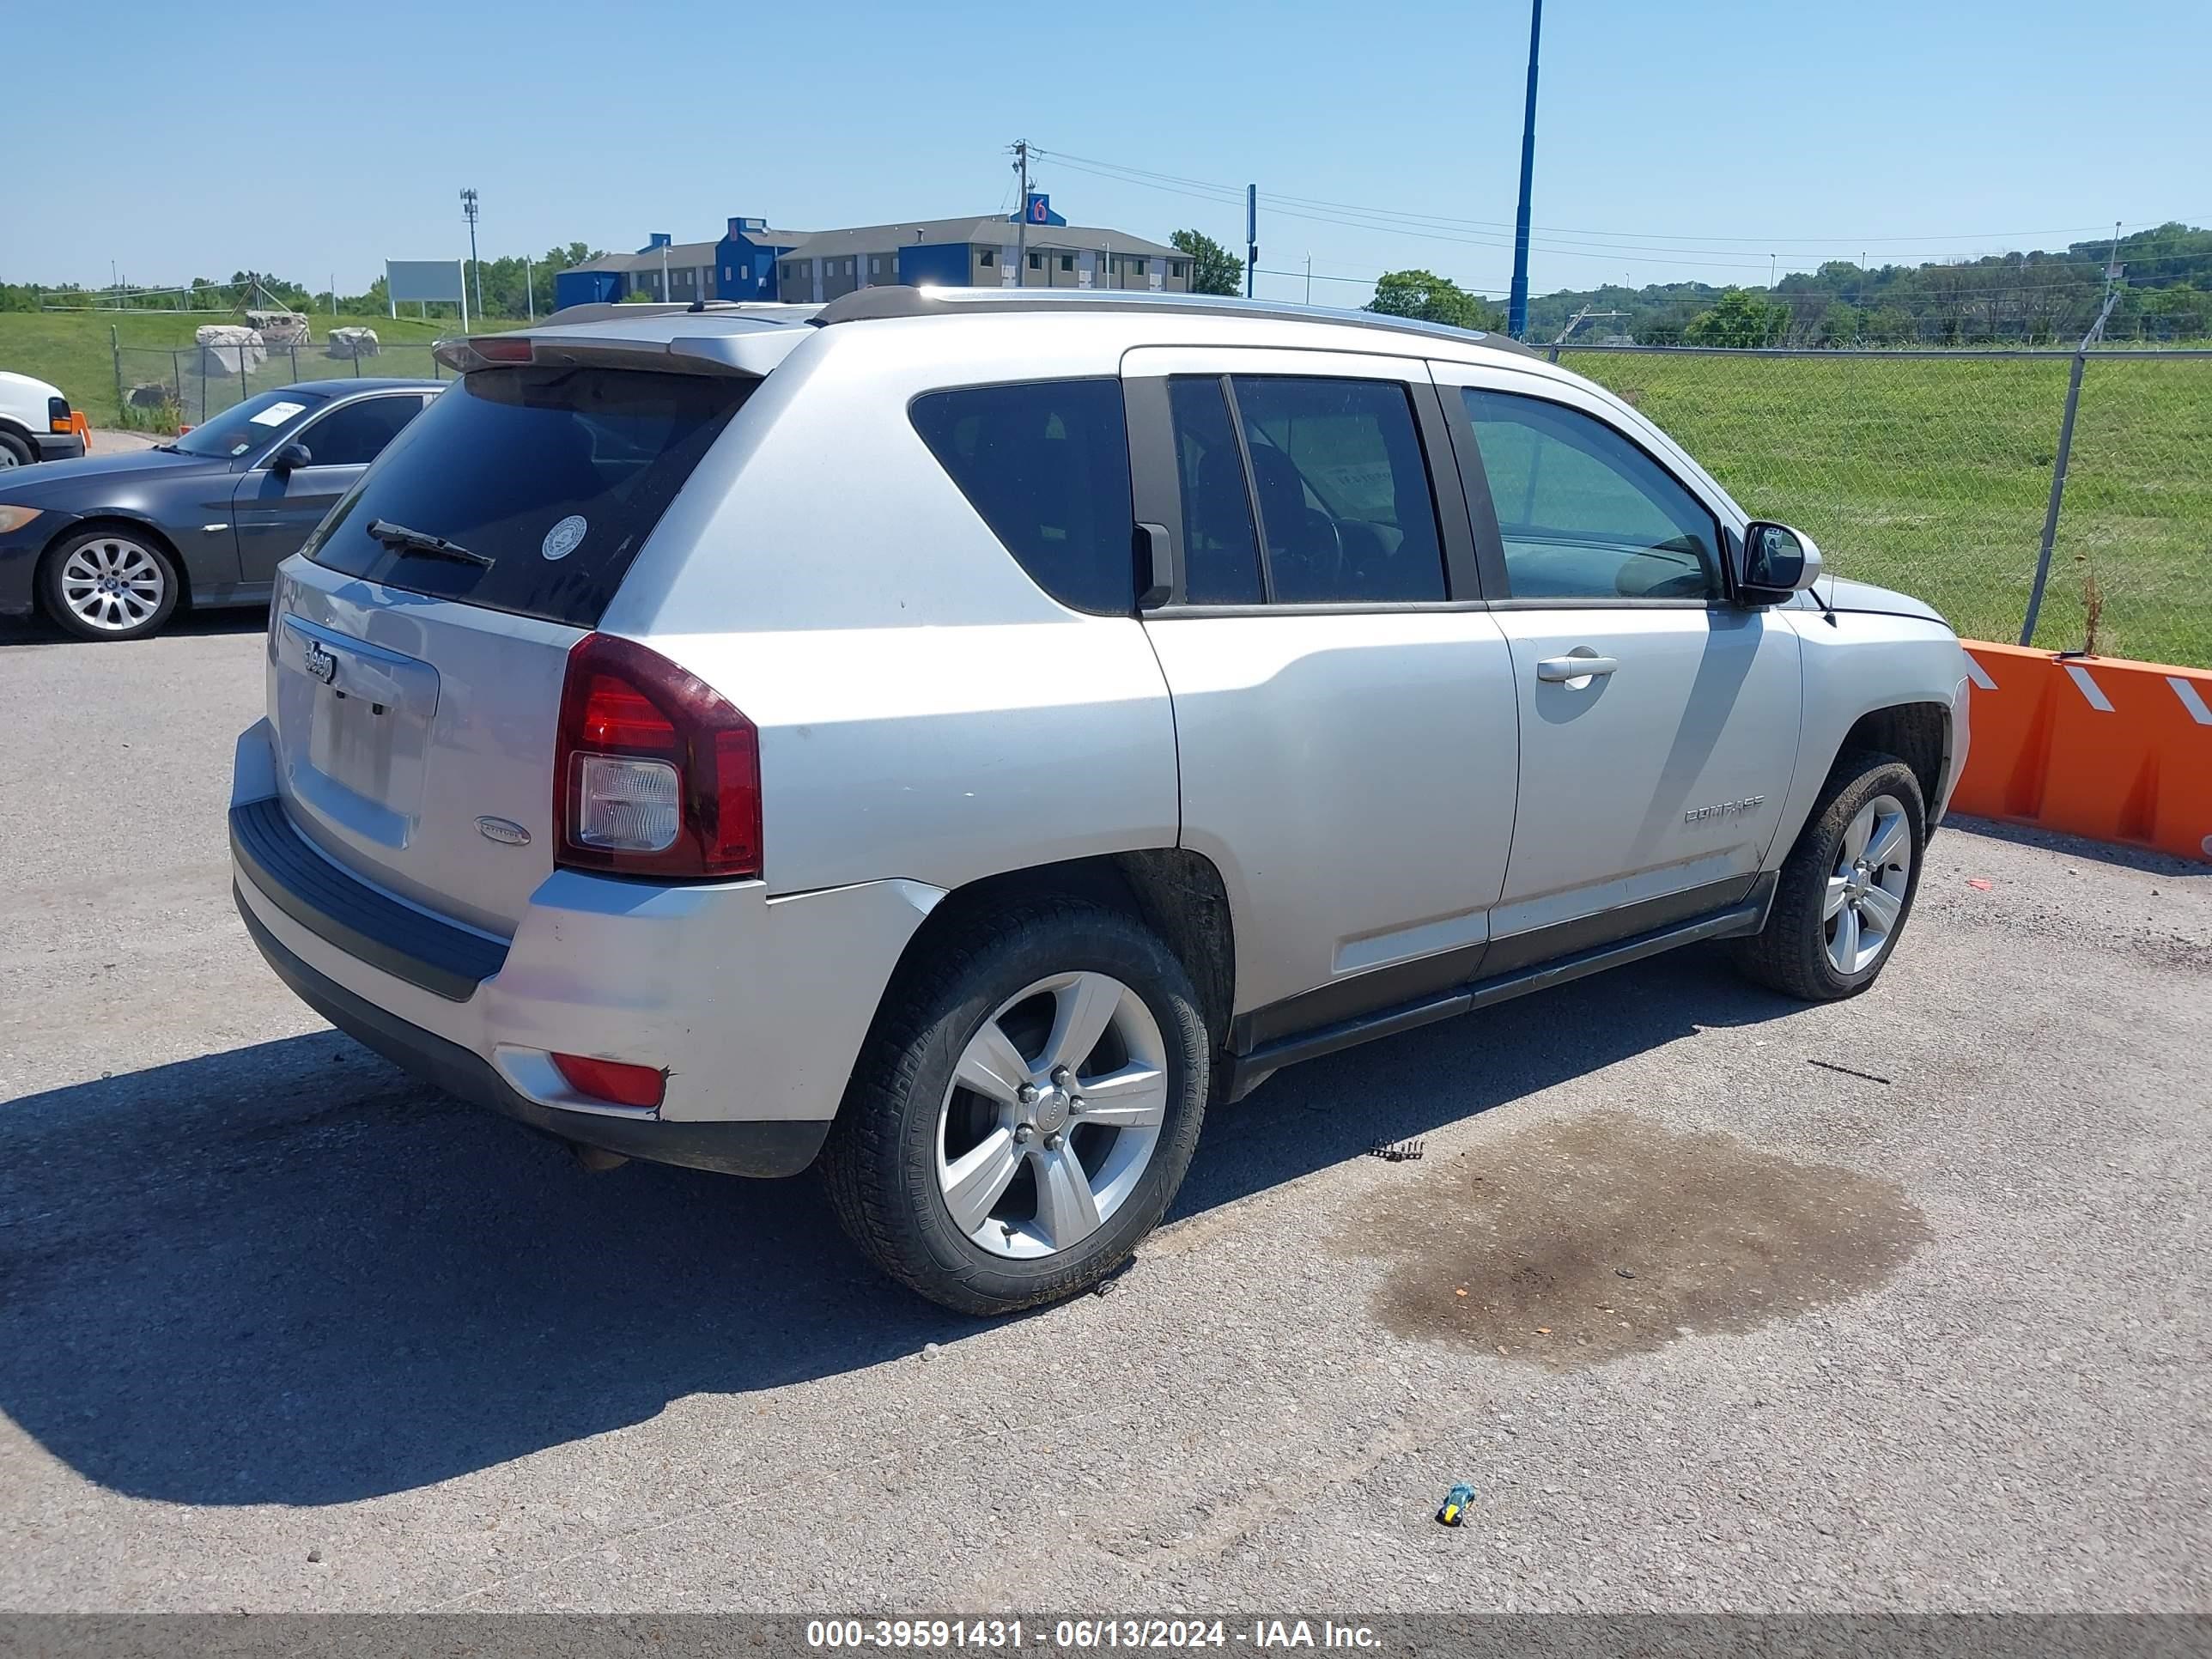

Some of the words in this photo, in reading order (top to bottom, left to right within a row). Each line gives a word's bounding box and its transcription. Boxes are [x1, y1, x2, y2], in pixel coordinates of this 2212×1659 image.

[1034, 198, 1047, 222] 6
[305, 639, 334, 684] Jeep
[1172, 994, 1200, 1149] GOODYEAR
[908, 1105, 935, 1231] RELIANT
